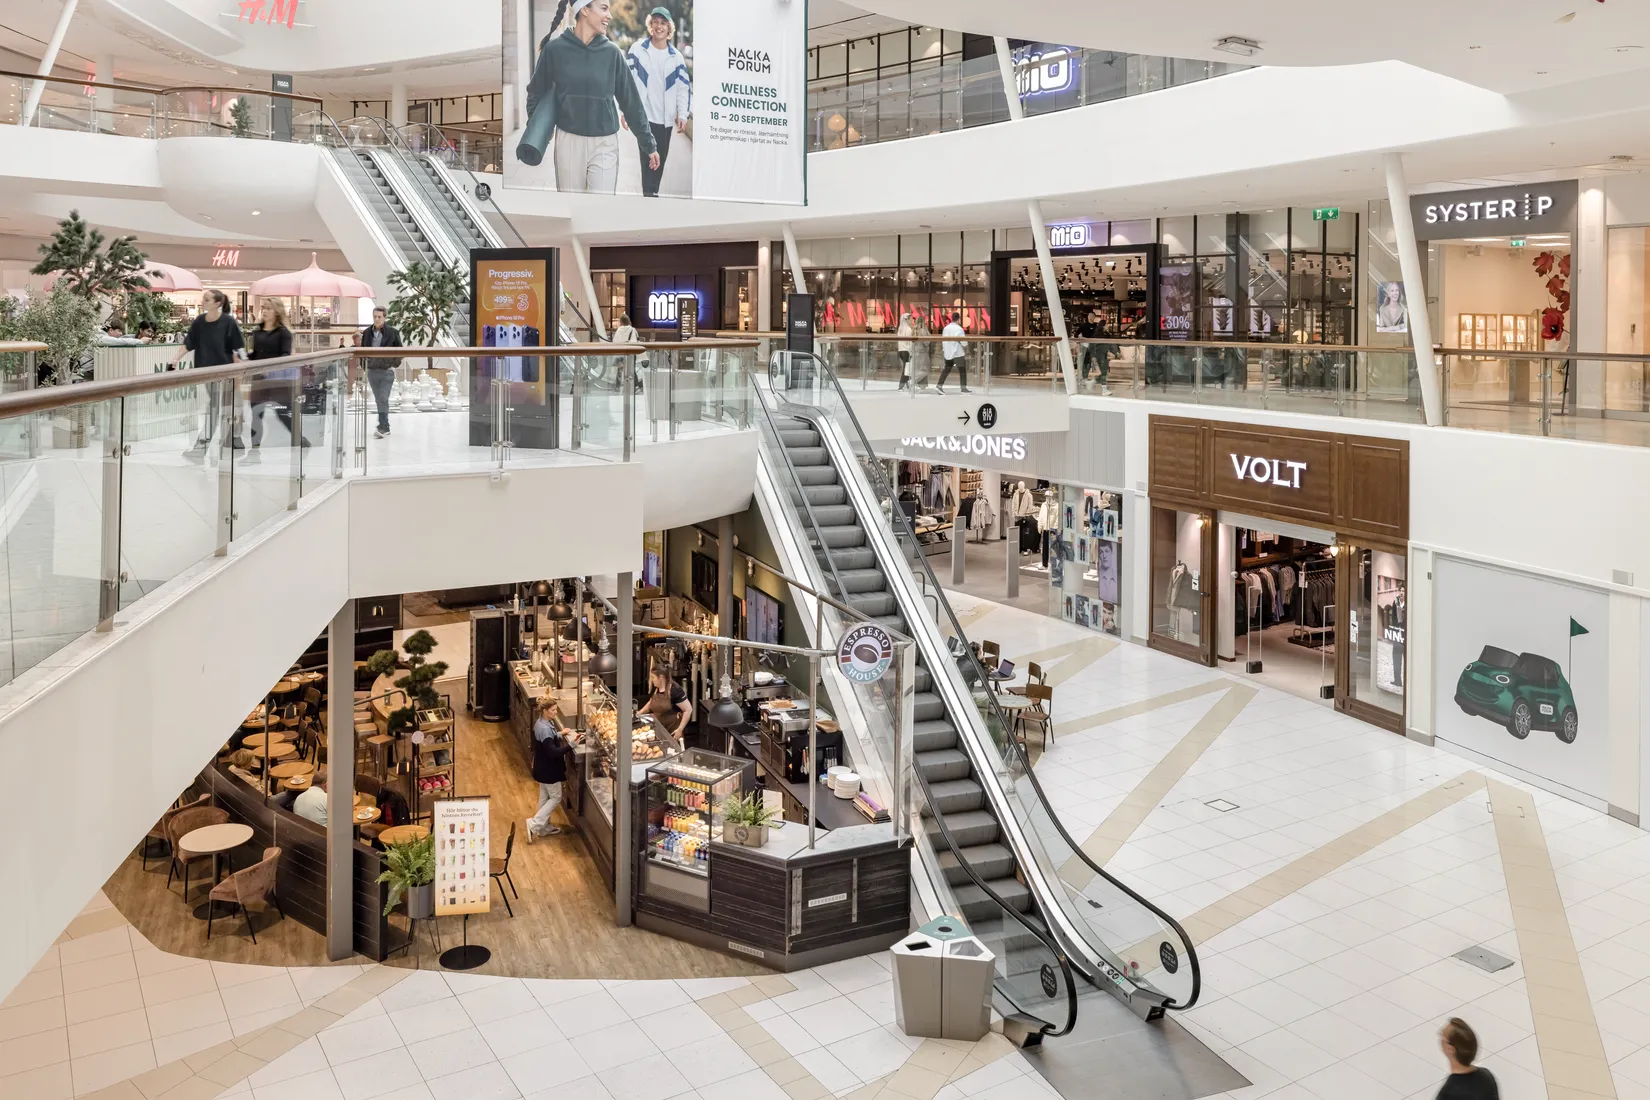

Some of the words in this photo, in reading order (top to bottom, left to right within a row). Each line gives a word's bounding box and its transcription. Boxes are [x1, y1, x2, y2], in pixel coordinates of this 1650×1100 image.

[728, 47, 771, 62] NACKA
[728, 59, 771, 74] FORUM
[721, 82, 777, 98] WELLNESS
[711, 95, 787, 113] CONNECTION
[710, 111, 719, 120] 18
[729, 113, 740, 122] 20
[741, 114, 788, 127] SEPTEMBER
[1425, 198, 1517, 224] SYSTER
[1537, 196, 1553, 216] P
[212, 249, 240, 267] H&M
[488, 269, 534, 279] Progressiv.
[1166, 315, 1190, 329] 30%
[1230, 453, 1307, 488] VOLT
[843, 627, 889, 651] ESPRESSO
[848, 664, 884, 680] HOUSE
